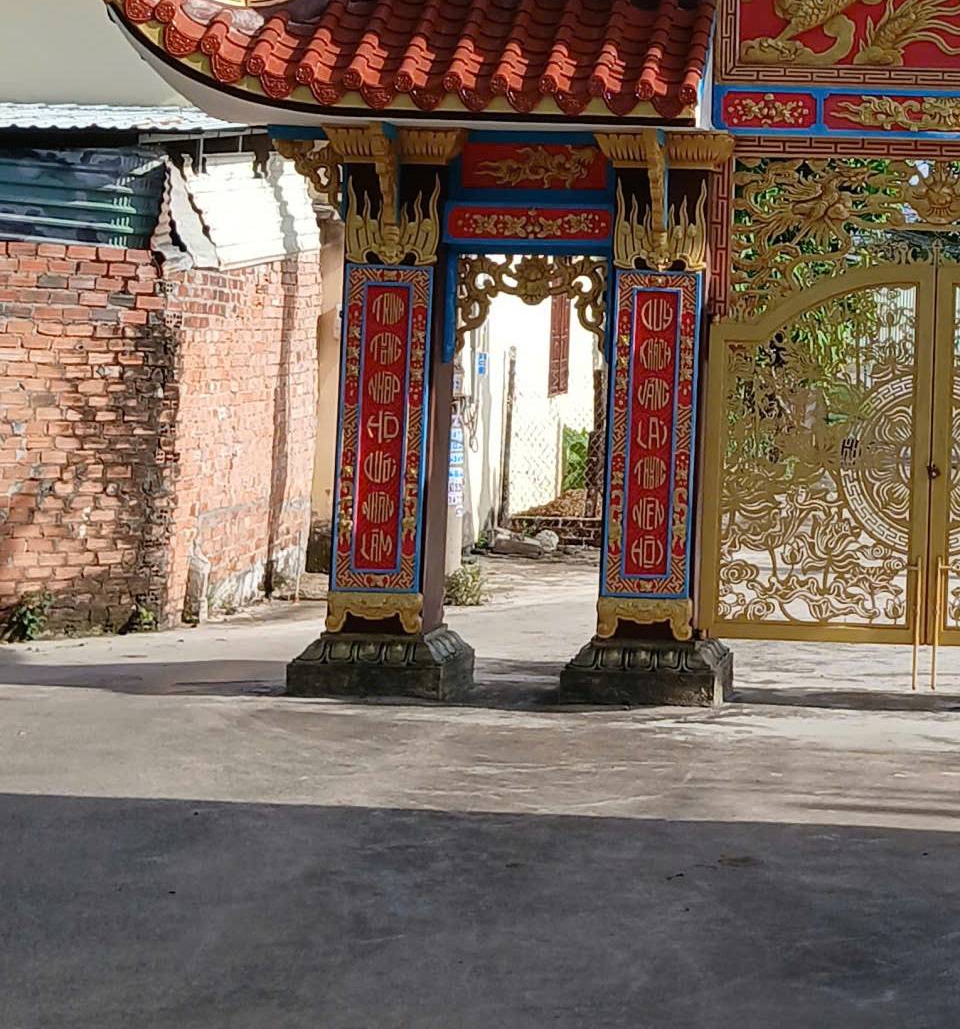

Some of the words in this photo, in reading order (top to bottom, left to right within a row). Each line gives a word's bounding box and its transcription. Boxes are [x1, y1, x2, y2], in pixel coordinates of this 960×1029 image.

[641, 298, 672, 331] QUÝ
[640, 338, 671, 371] KHÁCH
[631, 536, 663, 569] HỘI
